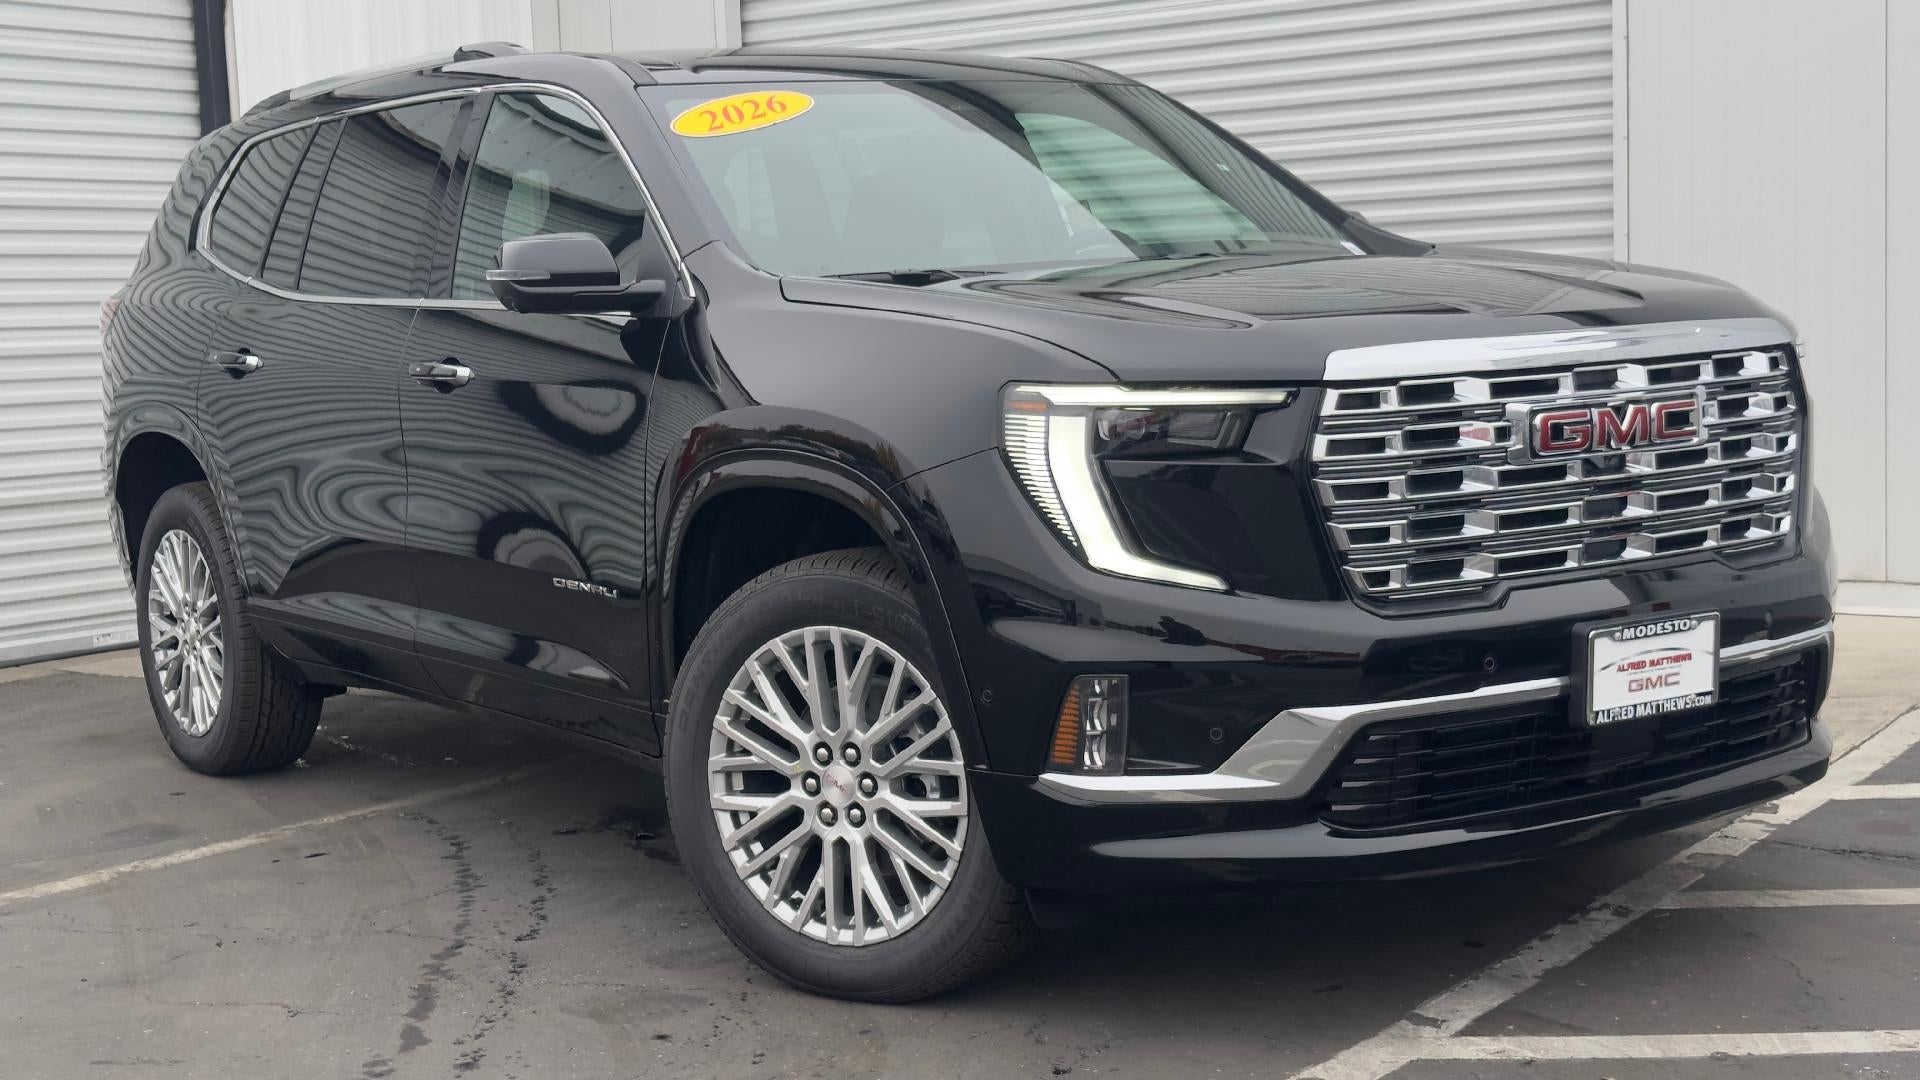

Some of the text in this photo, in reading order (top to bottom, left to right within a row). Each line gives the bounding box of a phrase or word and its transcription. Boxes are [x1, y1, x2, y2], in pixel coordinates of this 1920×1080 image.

[699, 95, 787, 132] 2026
[1533, 398, 1698, 456] GMC
[552, 577, 618, 599] DENALI
[1621, 619, 1690, 640] MODESTO
[1616, 660, 1647, 674] ALFRED
[1648, 652, 1693, 668] MATTHEWS
[1627, 672, 1681, 693] GMC
[1596, 705, 1634, 725] ALFRED
